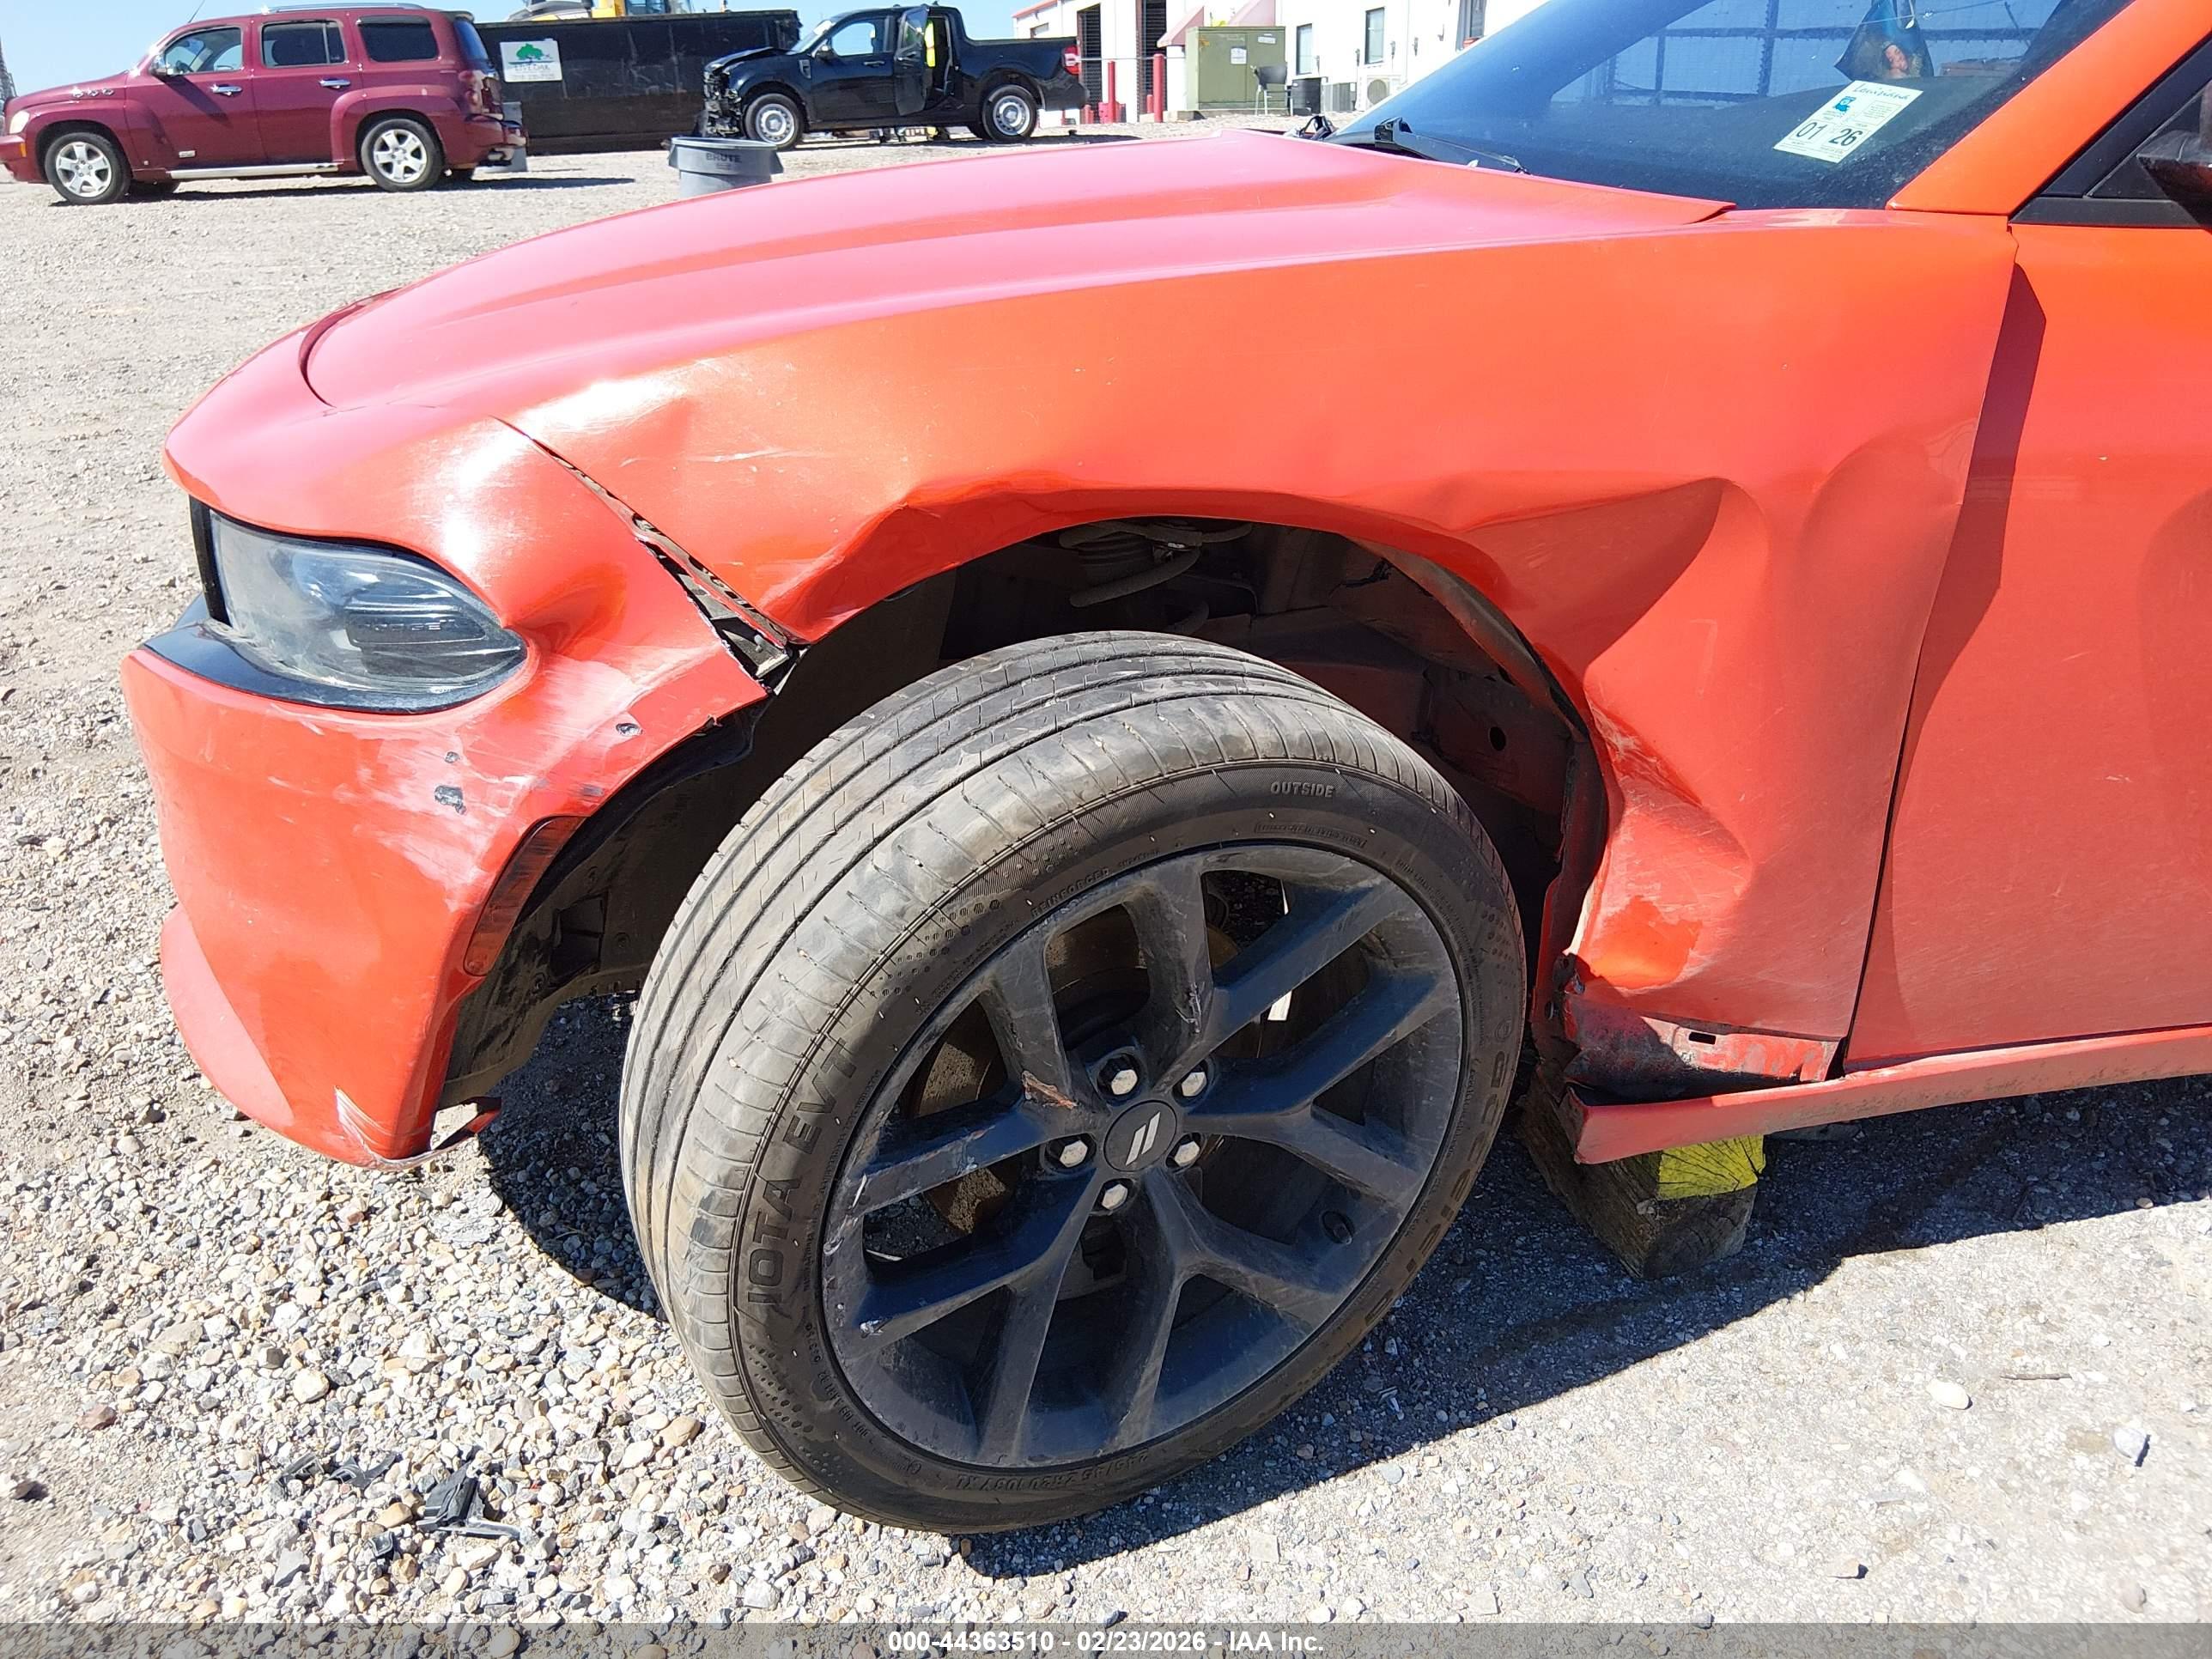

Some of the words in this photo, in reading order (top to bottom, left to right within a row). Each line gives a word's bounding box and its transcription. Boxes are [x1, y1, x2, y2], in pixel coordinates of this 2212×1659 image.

[1796, 122, 1827, 140] 01
[1828, 129, 1863, 146] 26
[706, 152, 742, 163] BRUTE
[1271, 781, 1336, 799] OUTSIDE
[1031, 867, 1110, 917] REINFORCED
[748, 1179, 801, 1304] IOTA
[783, 1036, 856, 1155] EVT
